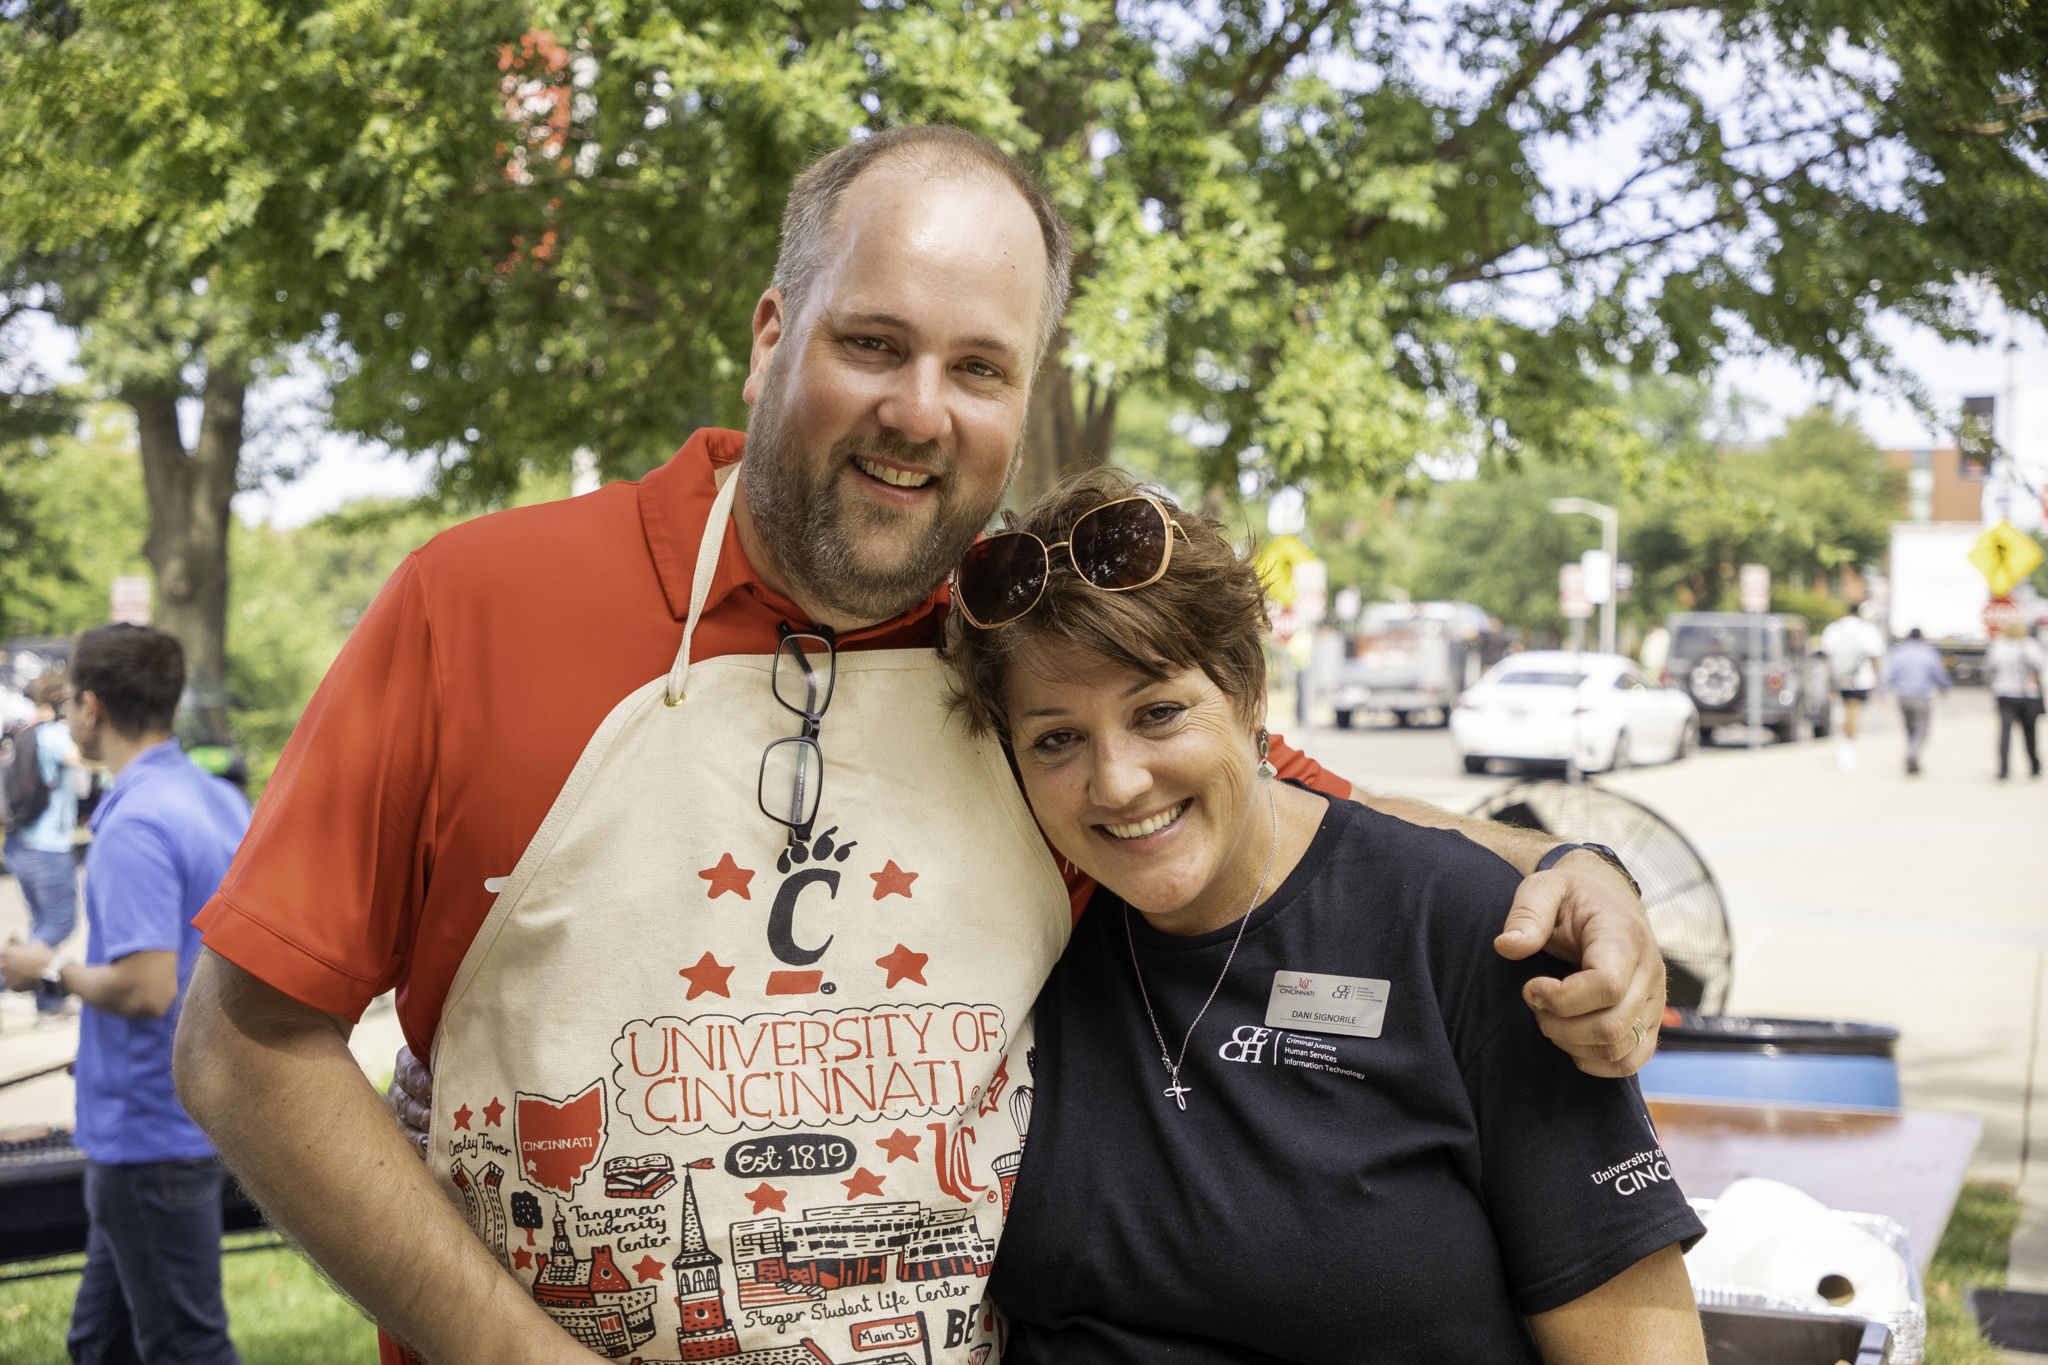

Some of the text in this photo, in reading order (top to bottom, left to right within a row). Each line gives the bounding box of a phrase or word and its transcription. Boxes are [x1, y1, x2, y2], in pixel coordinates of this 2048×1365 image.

[767, 868, 841, 966] C
[1279, 987, 1315, 997] CINCINNATI
[1291, 1010, 1357, 1024] DANI SIGNORILE
[629, 1010, 999, 1077] UNIVERSITY OF
[1284, 1047, 1338, 1063] Human Services
[1286, 1037, 1314, 1047] Criminal
[1313, 1042, 1337, 1052] Justice
[1284, 1058, 1366, 1081] Information Technology
[644, 1060, 966, 1123] CINCINNATI
[478, 1133, 513, 1157] Tower
[523, 1136, 593, 1151] CINCINNATI
[787, 1142, 847, 1170] 1819
[1591, 1150, 1654, 1185] University
[569, 1203, 665, 1227] Tangeman
[575, 1215, 667, 1237] University
[617, 1234, 671, 1253] Center
[744, 1282, 970, 1334] Steger Student Life Center
[858, 1322, 917, 1346] Main St.
